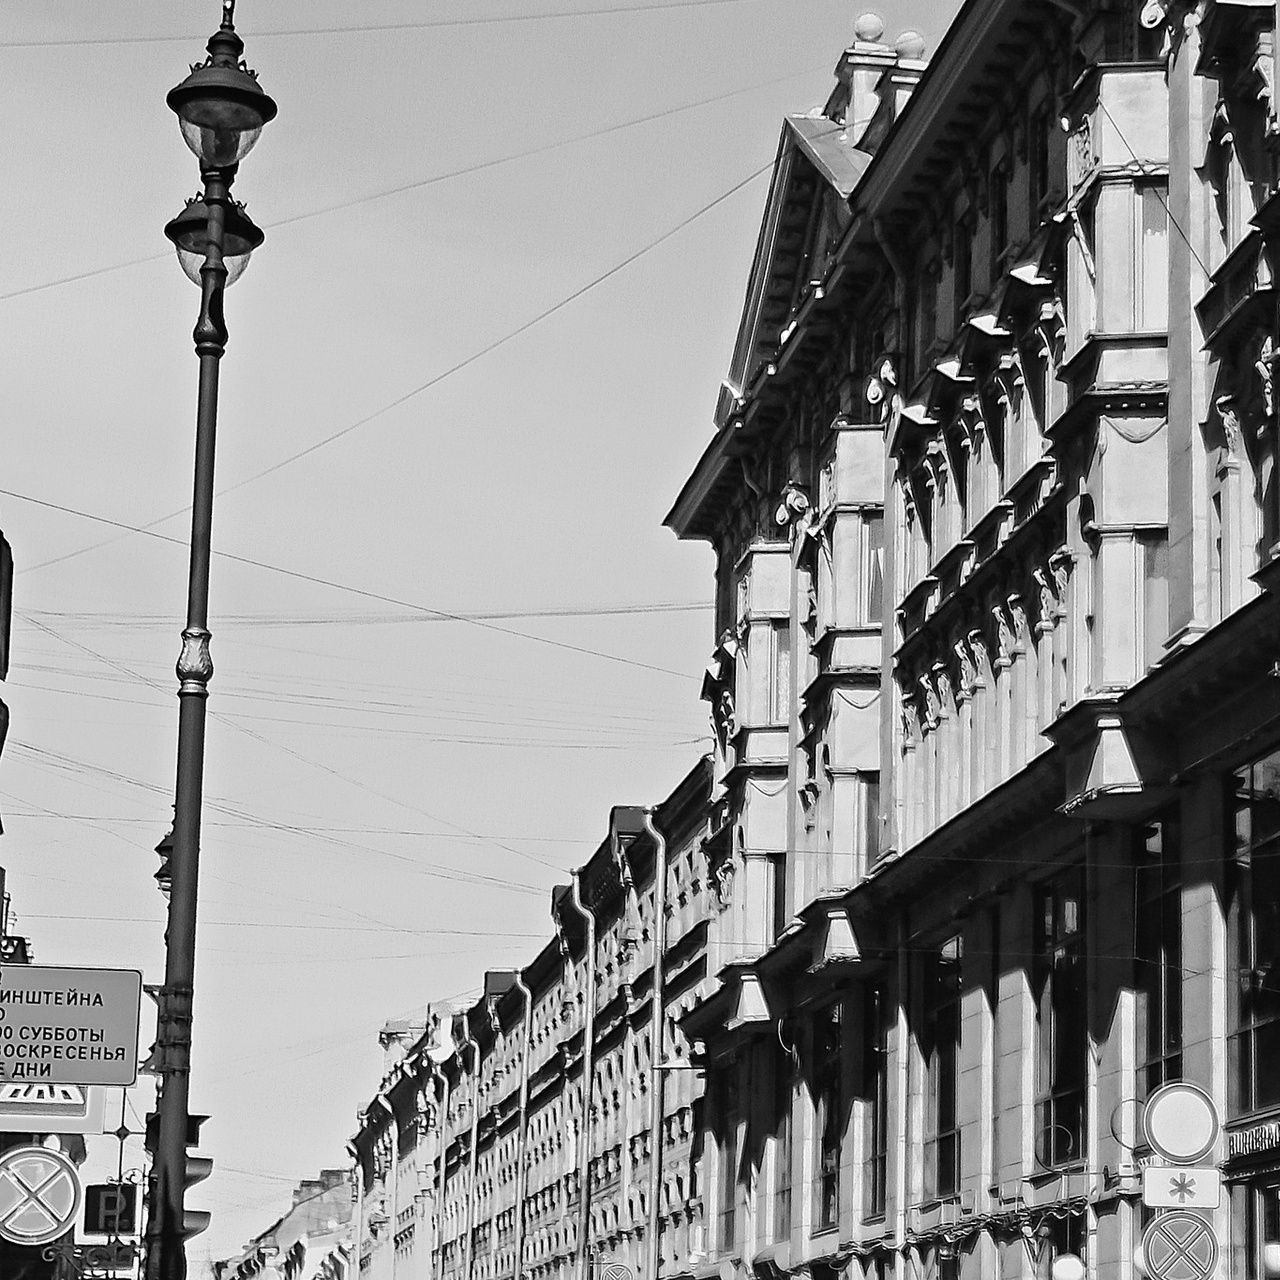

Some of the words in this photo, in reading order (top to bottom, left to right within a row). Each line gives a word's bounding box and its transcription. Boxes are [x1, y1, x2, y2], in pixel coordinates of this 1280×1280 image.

[19, 1026, 104, 1043] СУББОТЫ
[0, 1043, 126, 1061] ОСКРЕСЕНЬЯ
[11, 1062, 52, 1079] ДНИ
